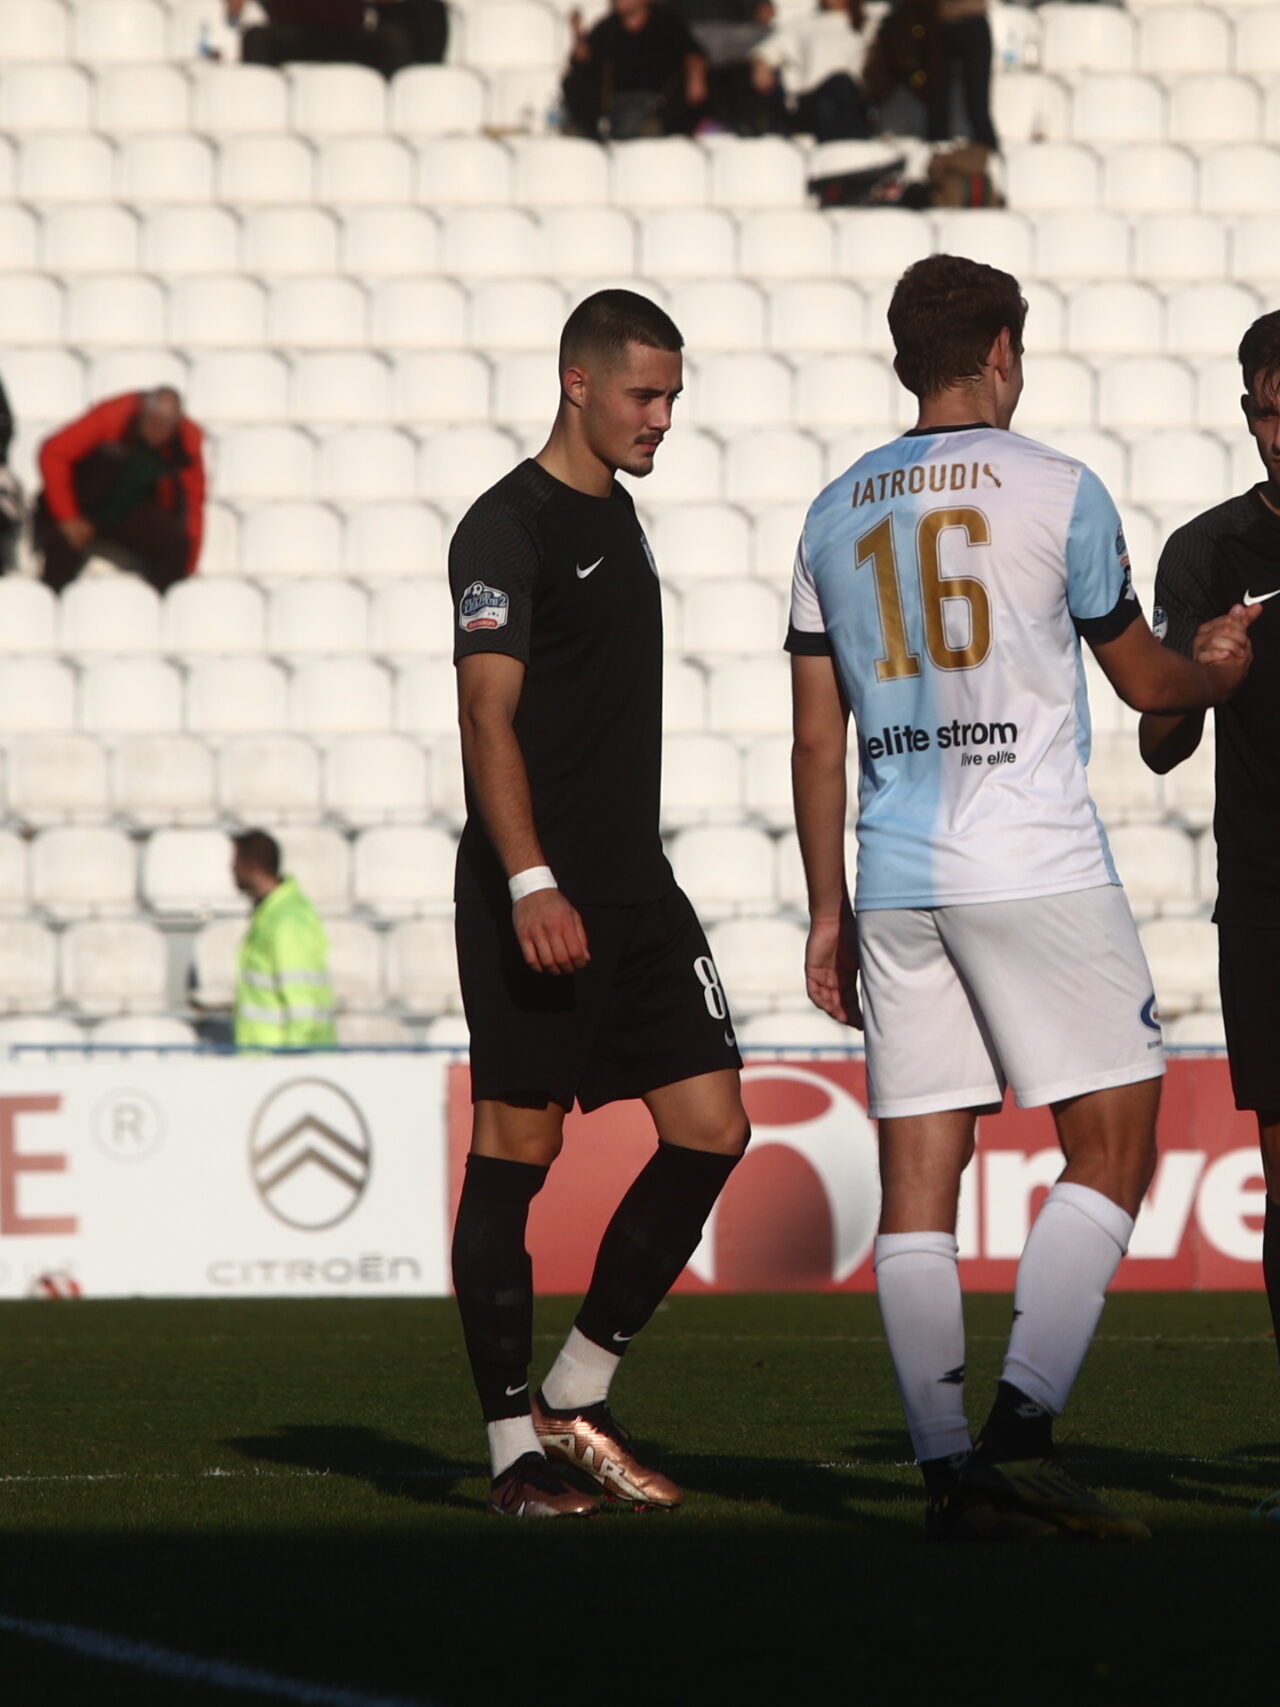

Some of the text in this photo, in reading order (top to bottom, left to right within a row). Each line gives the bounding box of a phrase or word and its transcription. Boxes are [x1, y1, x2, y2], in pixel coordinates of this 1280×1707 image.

[854, 505, 993, 684] 16
[868, 719, 1018, 760] elite strom
[961, 751, 1016, 766] live elite
[693, 956, 726, 1020] 8
